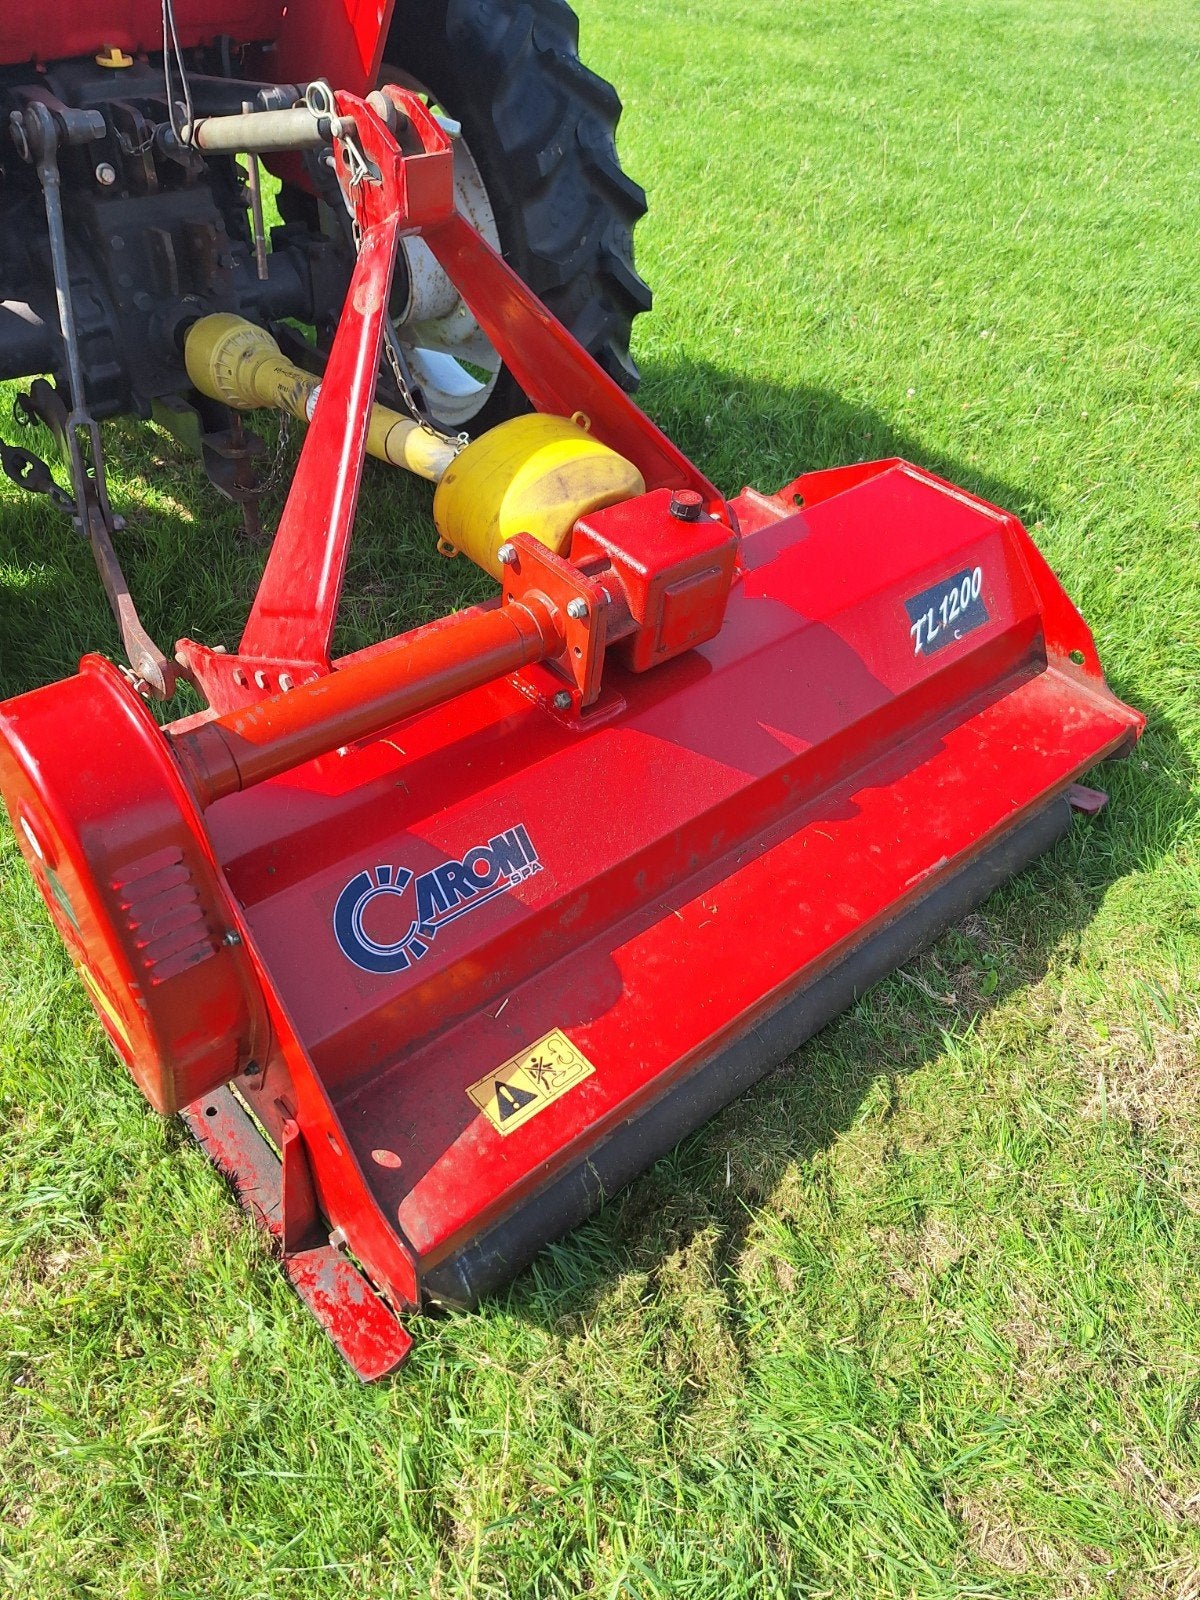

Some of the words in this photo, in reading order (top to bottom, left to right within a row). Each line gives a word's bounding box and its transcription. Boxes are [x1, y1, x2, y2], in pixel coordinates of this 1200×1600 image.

[910, 607, 940, 657] TL
[939, 566, 982, 630] 1200
[333, 822, 539, 975] CARONI
[510, 859, 544, 886] SPA
